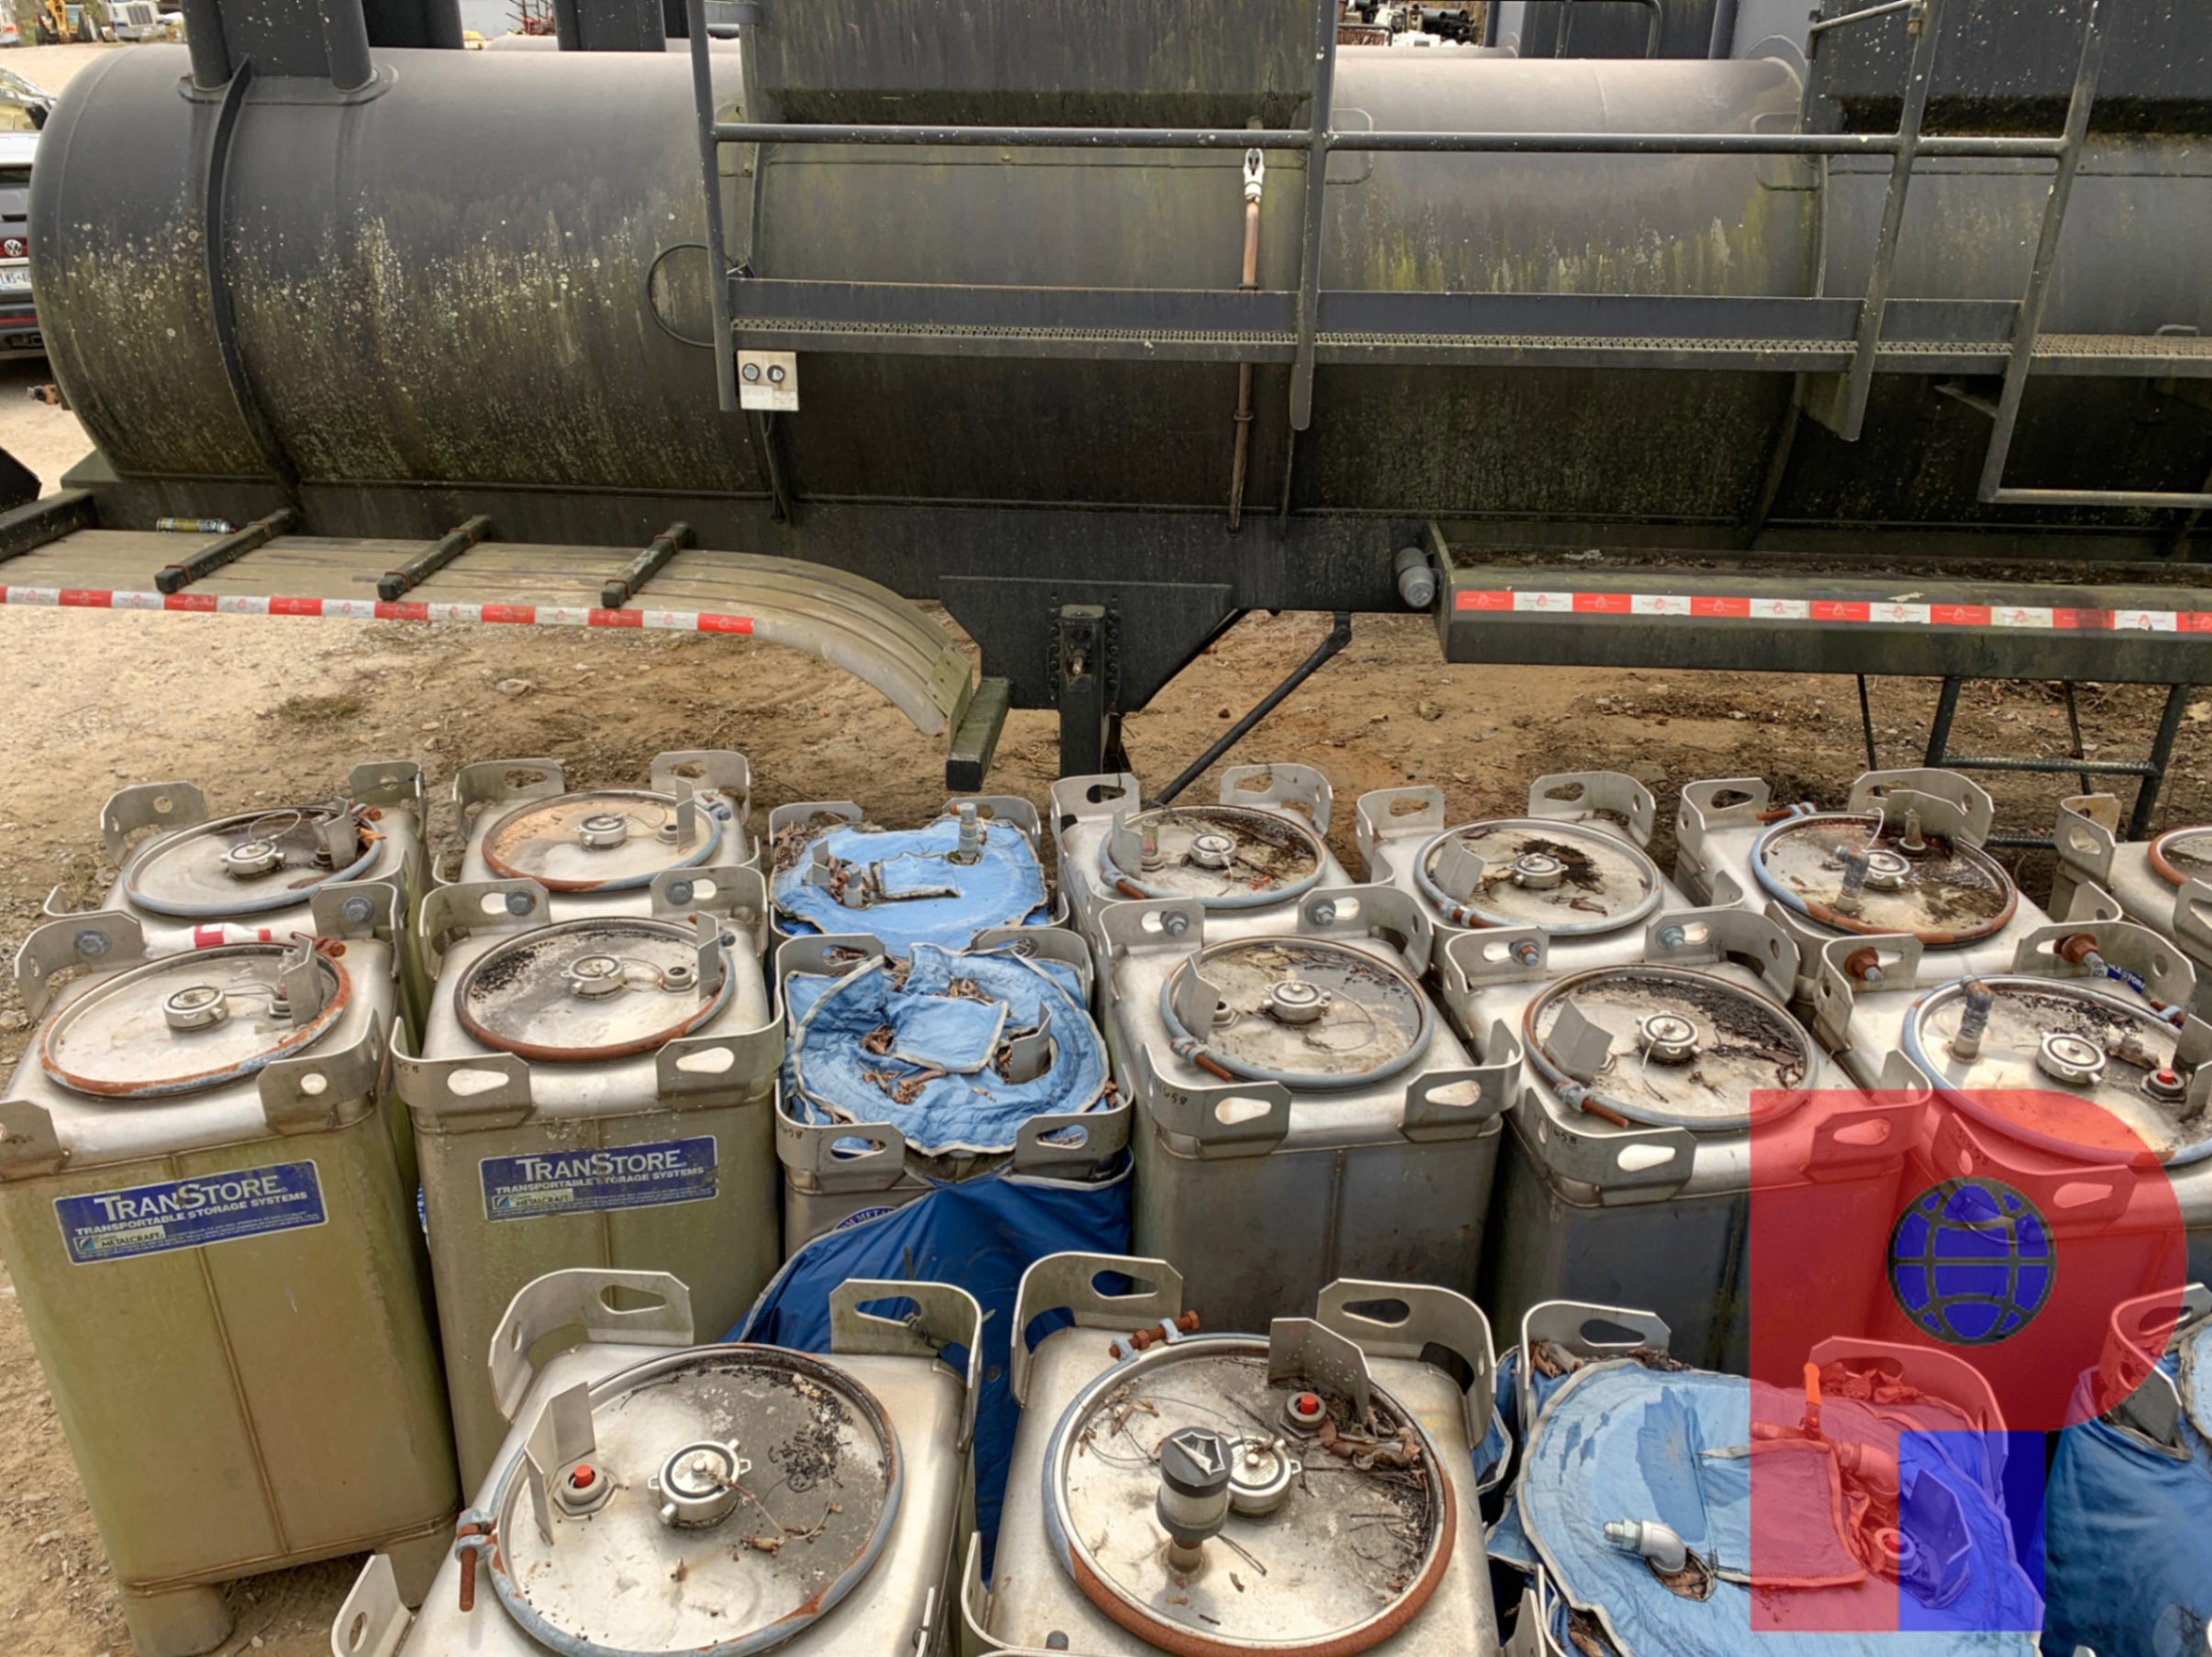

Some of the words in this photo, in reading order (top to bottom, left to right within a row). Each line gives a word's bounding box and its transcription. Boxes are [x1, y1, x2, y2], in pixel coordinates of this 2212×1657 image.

[495, 1178, 593, 1195] TRANSPORTABLE
[652, 1166, 705, 1180] SYSTEMS
[75, 1212, 185, 1236] TRANSPORTABLE
[187, 1200, 248, 1219] STORAGE
[250, 1191, 308, 1208] SYSTEMS
